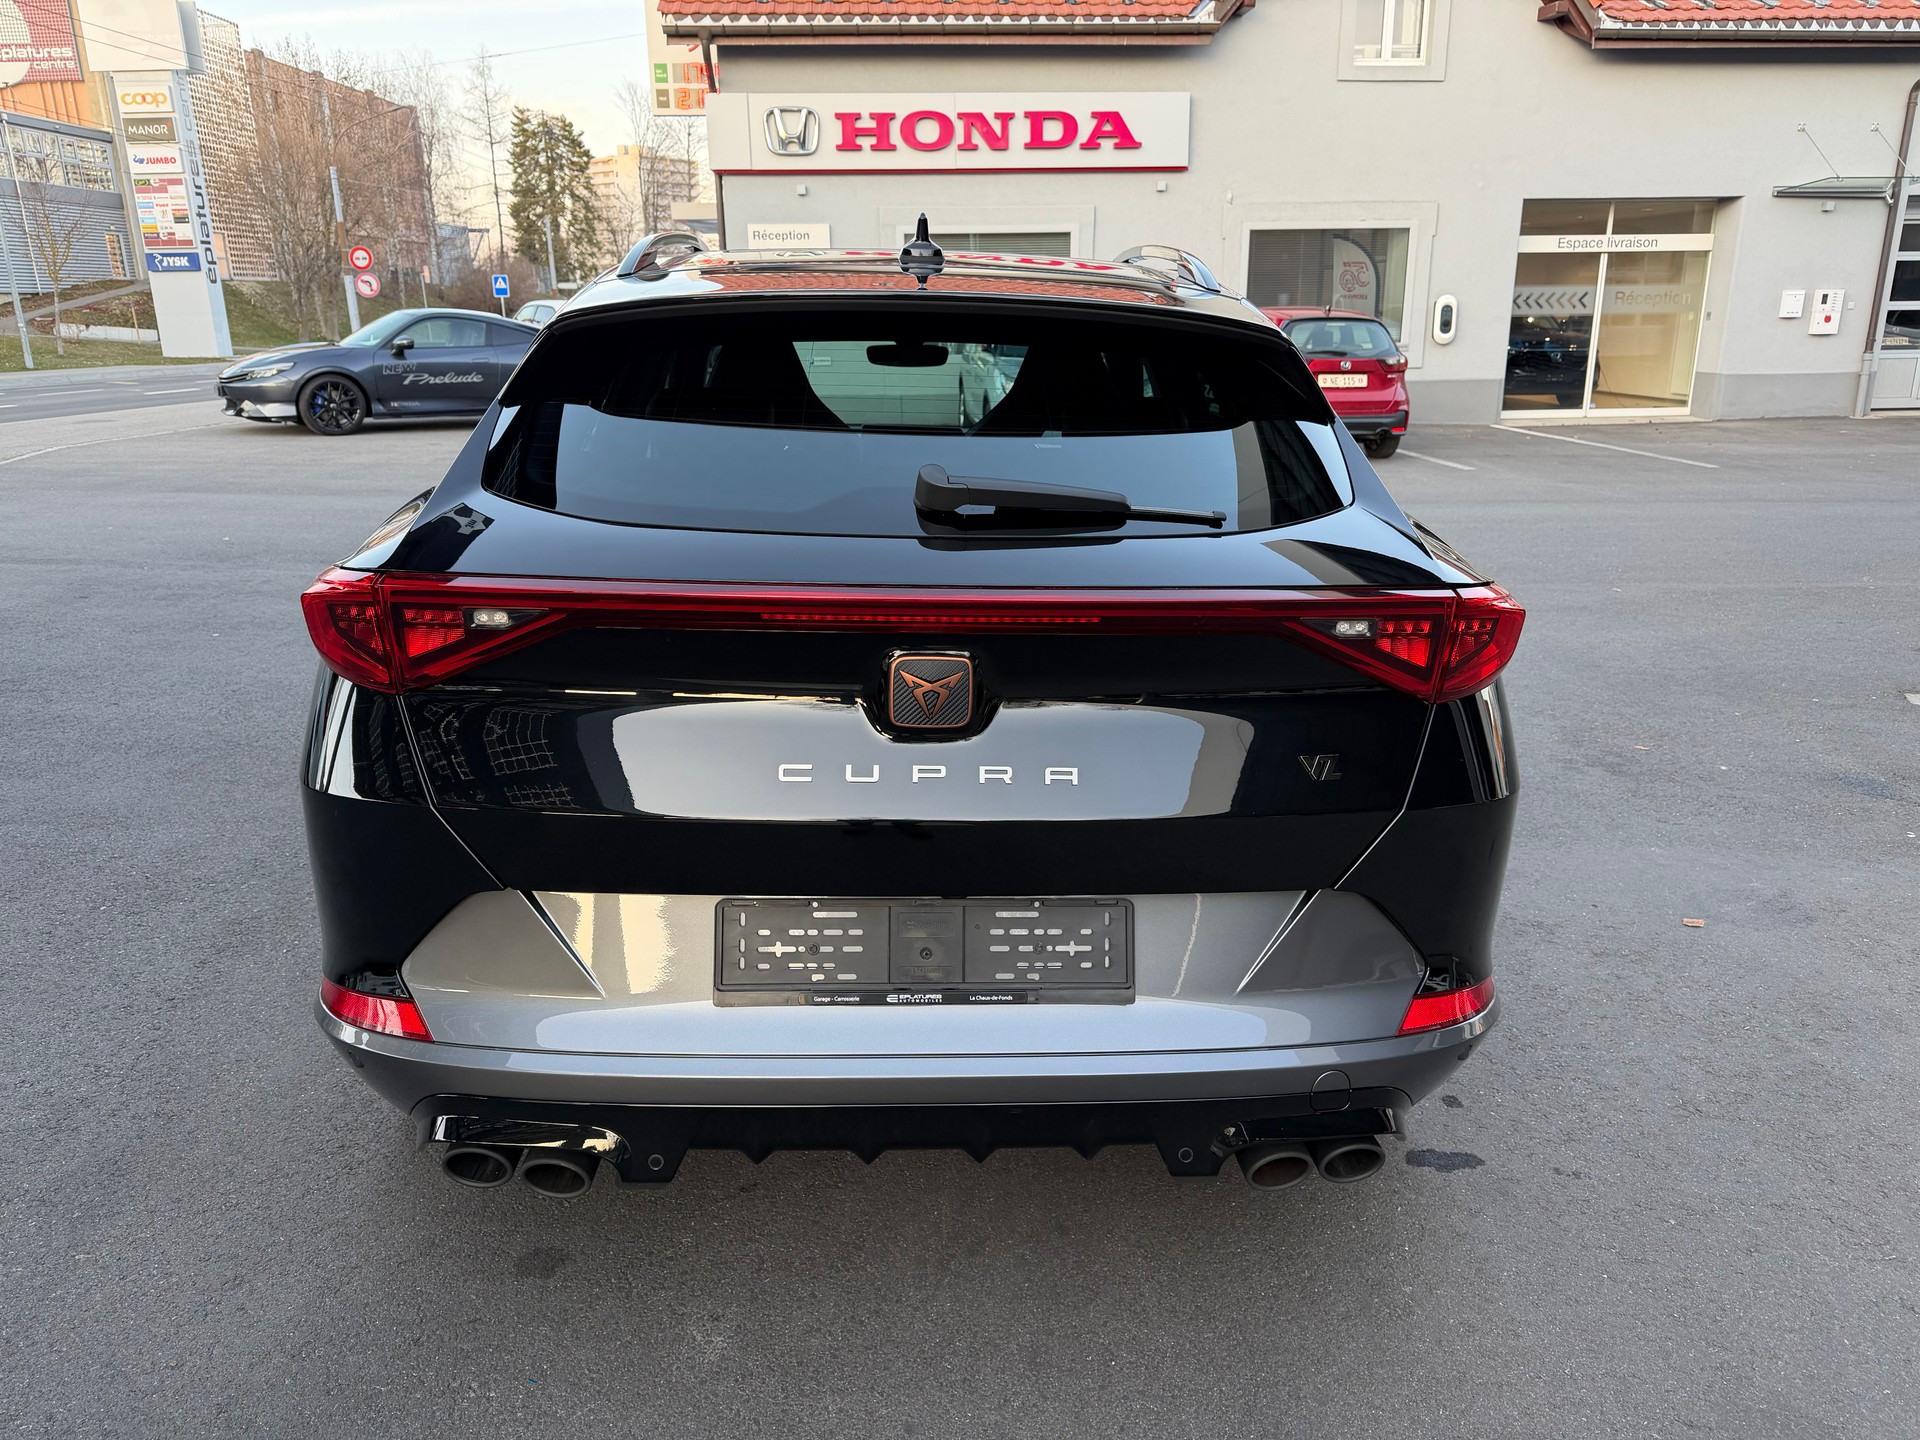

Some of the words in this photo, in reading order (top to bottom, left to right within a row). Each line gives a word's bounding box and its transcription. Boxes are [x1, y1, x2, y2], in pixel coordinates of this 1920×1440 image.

[0, 45, 73, 61] platures
[33, 59, 75, 69] centre
[120, 92, 168, 108] coop
[128, 125, 169, 135] MANOR
[834, 110, 1142, 151] HONDA
[145, 156, 177, 165] JUMBO
[186, 138, 218, 285] éplatures
[752, 229, 810, 242] Réception
[1557, 237, 1603, 250] Espace
[1607, 236, 1658, 248] livraison
[161, 256, 190, 267] JYSK
[1614, 289, 1691, 307] Réception
[382, 363, 417, 375] NEW
[402, 371, 484, 385] Prelude
[778, 763, 1079, 786] CUPRA
